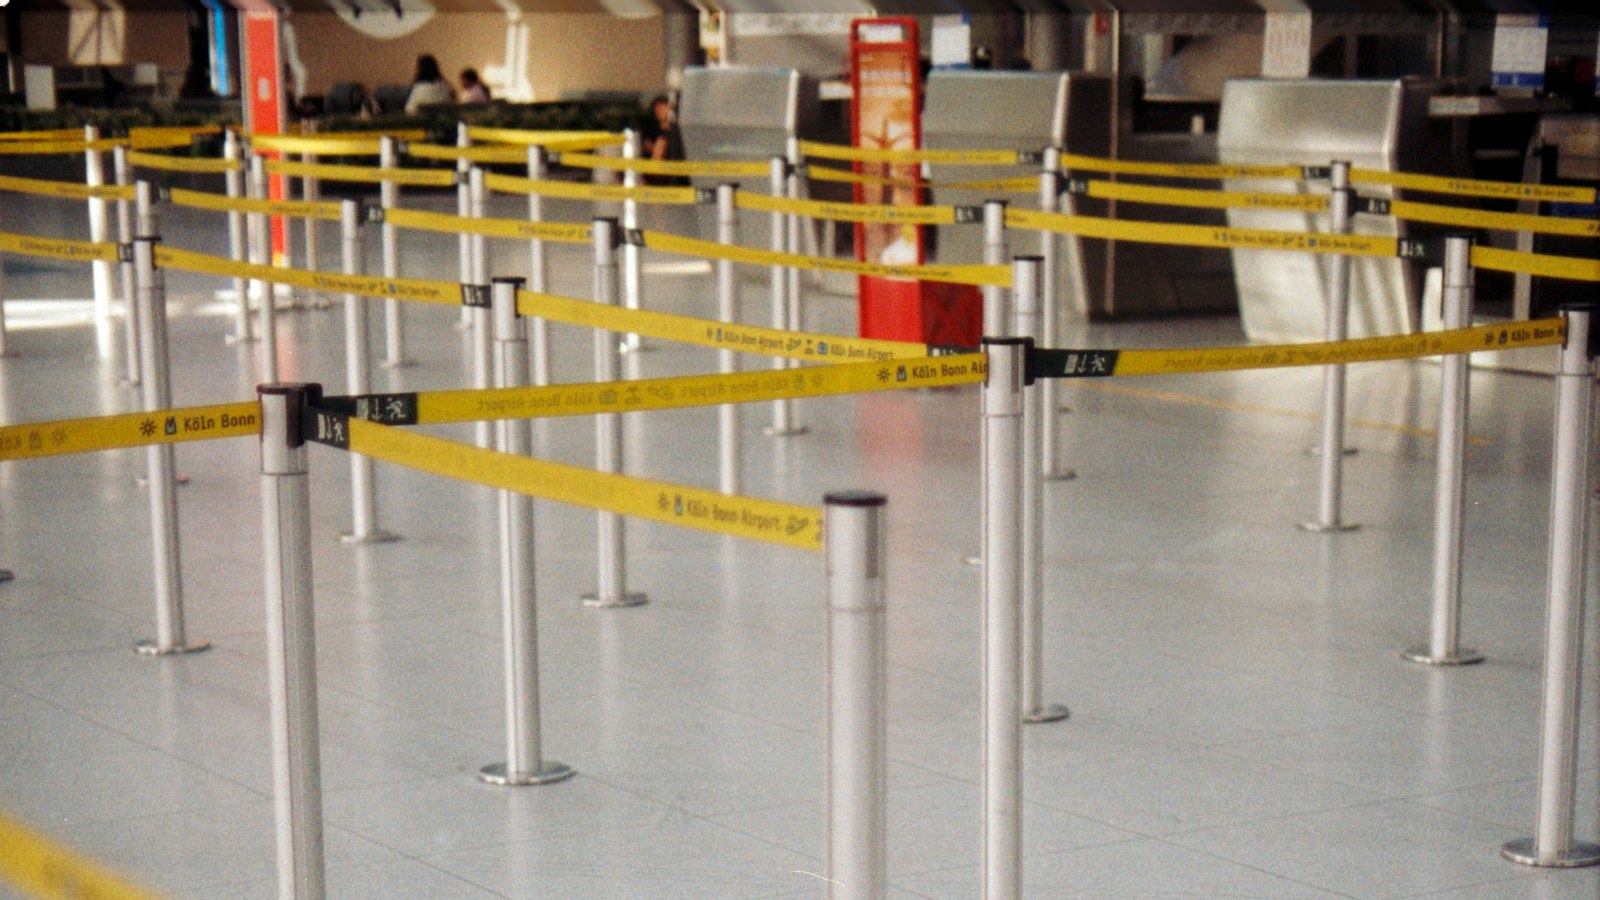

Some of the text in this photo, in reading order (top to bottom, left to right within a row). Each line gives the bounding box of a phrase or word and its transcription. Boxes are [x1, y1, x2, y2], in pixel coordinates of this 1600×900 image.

[1533, 328, 1554, 339] Bonn
[912, 365, 937, 379] Köln
[941, 363, 967, 377] Bonn
[184, 413, 256, 432] Köln Bonn
[687, 499, 780, 531] Köln Bonn Airport
